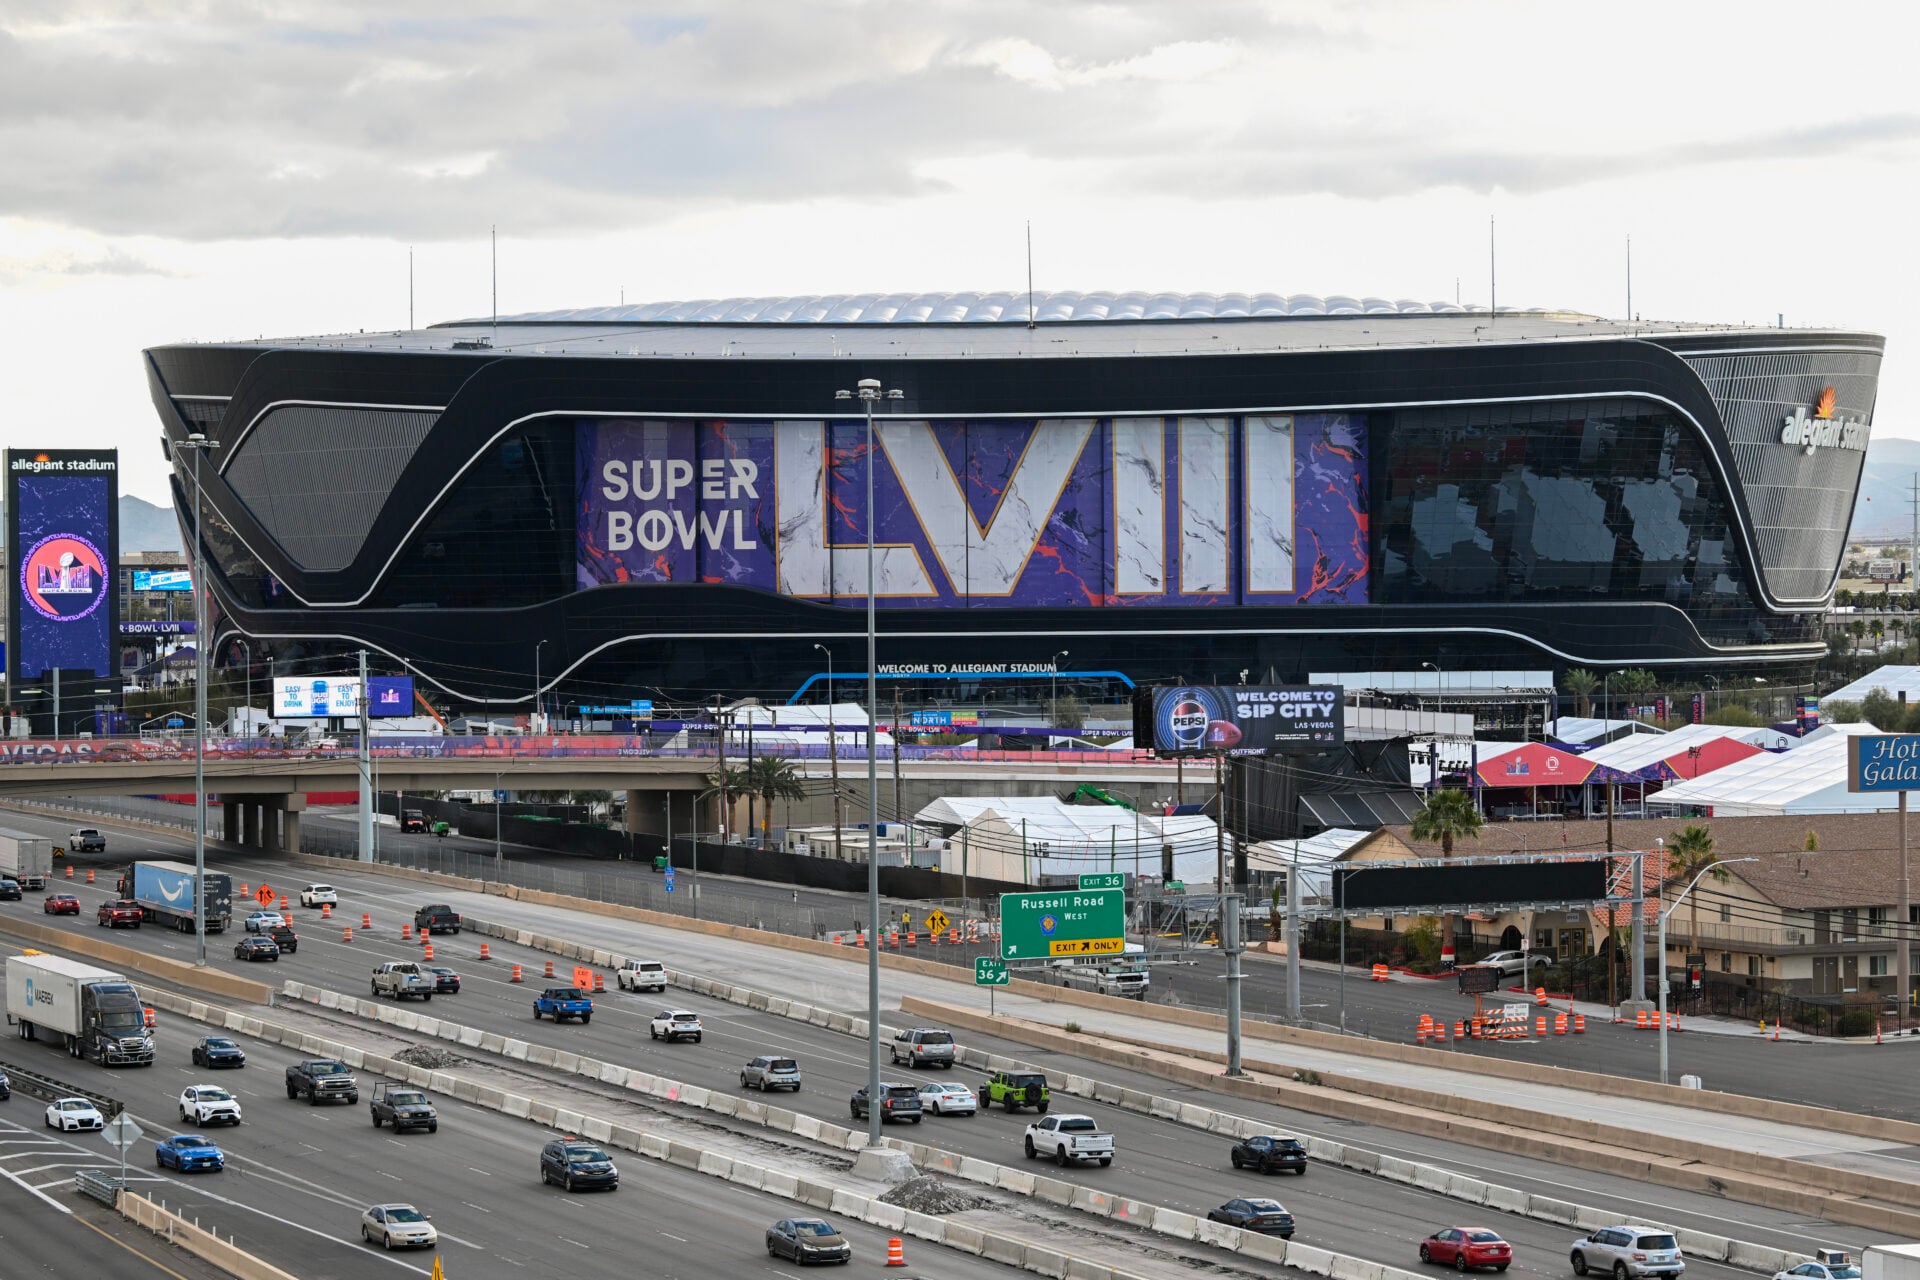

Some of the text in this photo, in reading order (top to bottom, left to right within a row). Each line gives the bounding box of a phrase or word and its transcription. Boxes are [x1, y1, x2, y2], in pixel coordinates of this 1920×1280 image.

[1781, 407, 1844, 456] allegiant
[11, 459, 115, 473] allegiant stadium
[602, 458, 759, 502] SUPER
[774, 416, 1294, 597] LVIII
[607, 509, 758, 552] BOWL
[877, 663, 1057, 673] WELCOME TO ALLEGIANT STADIUM
[285, 685, 301, 693] EASY
[337, 685, 353, 693] EASY
[1236, 691, 1335, 702] WELCOME TO
[283, 700, 303, 708] DRINK
[1237, 702, 1335, 718] SIP CITY
[913, 716, 947, 724] NORTH
[1173, 717, 1205, 726] PEPSI
[1310, 721, 1334, 729] VEGAS
[1863, 758, 1920, 786] Gala
[1083, 876, 1120, 886] EXIT 36
[1021, 896, 1104, 909] Russell Road
[1064, 912, 1088, 920] WEST
[1056, 942, 1118, 952] EXIT ONLY
[978, 969, 995, 980] 36
[34, 987, 54, 1006] MAERSK
